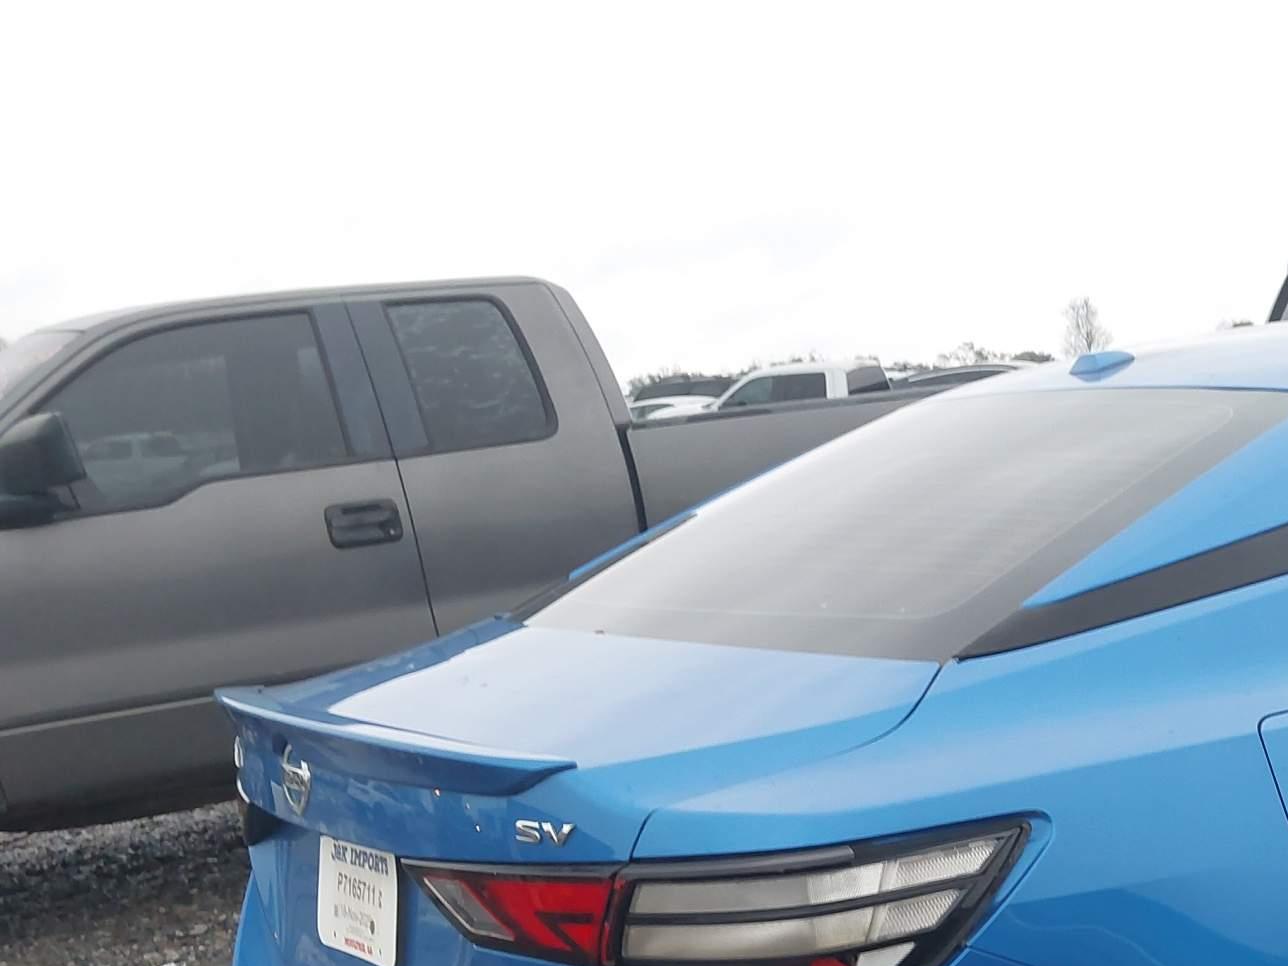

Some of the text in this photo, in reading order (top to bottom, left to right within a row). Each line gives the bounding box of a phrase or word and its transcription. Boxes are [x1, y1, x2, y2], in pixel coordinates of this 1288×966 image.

[514, 819, 576, 847] SV
[350, 847, 389, 877] IMPORTS
[337, 871, 376, 906] P7165711
